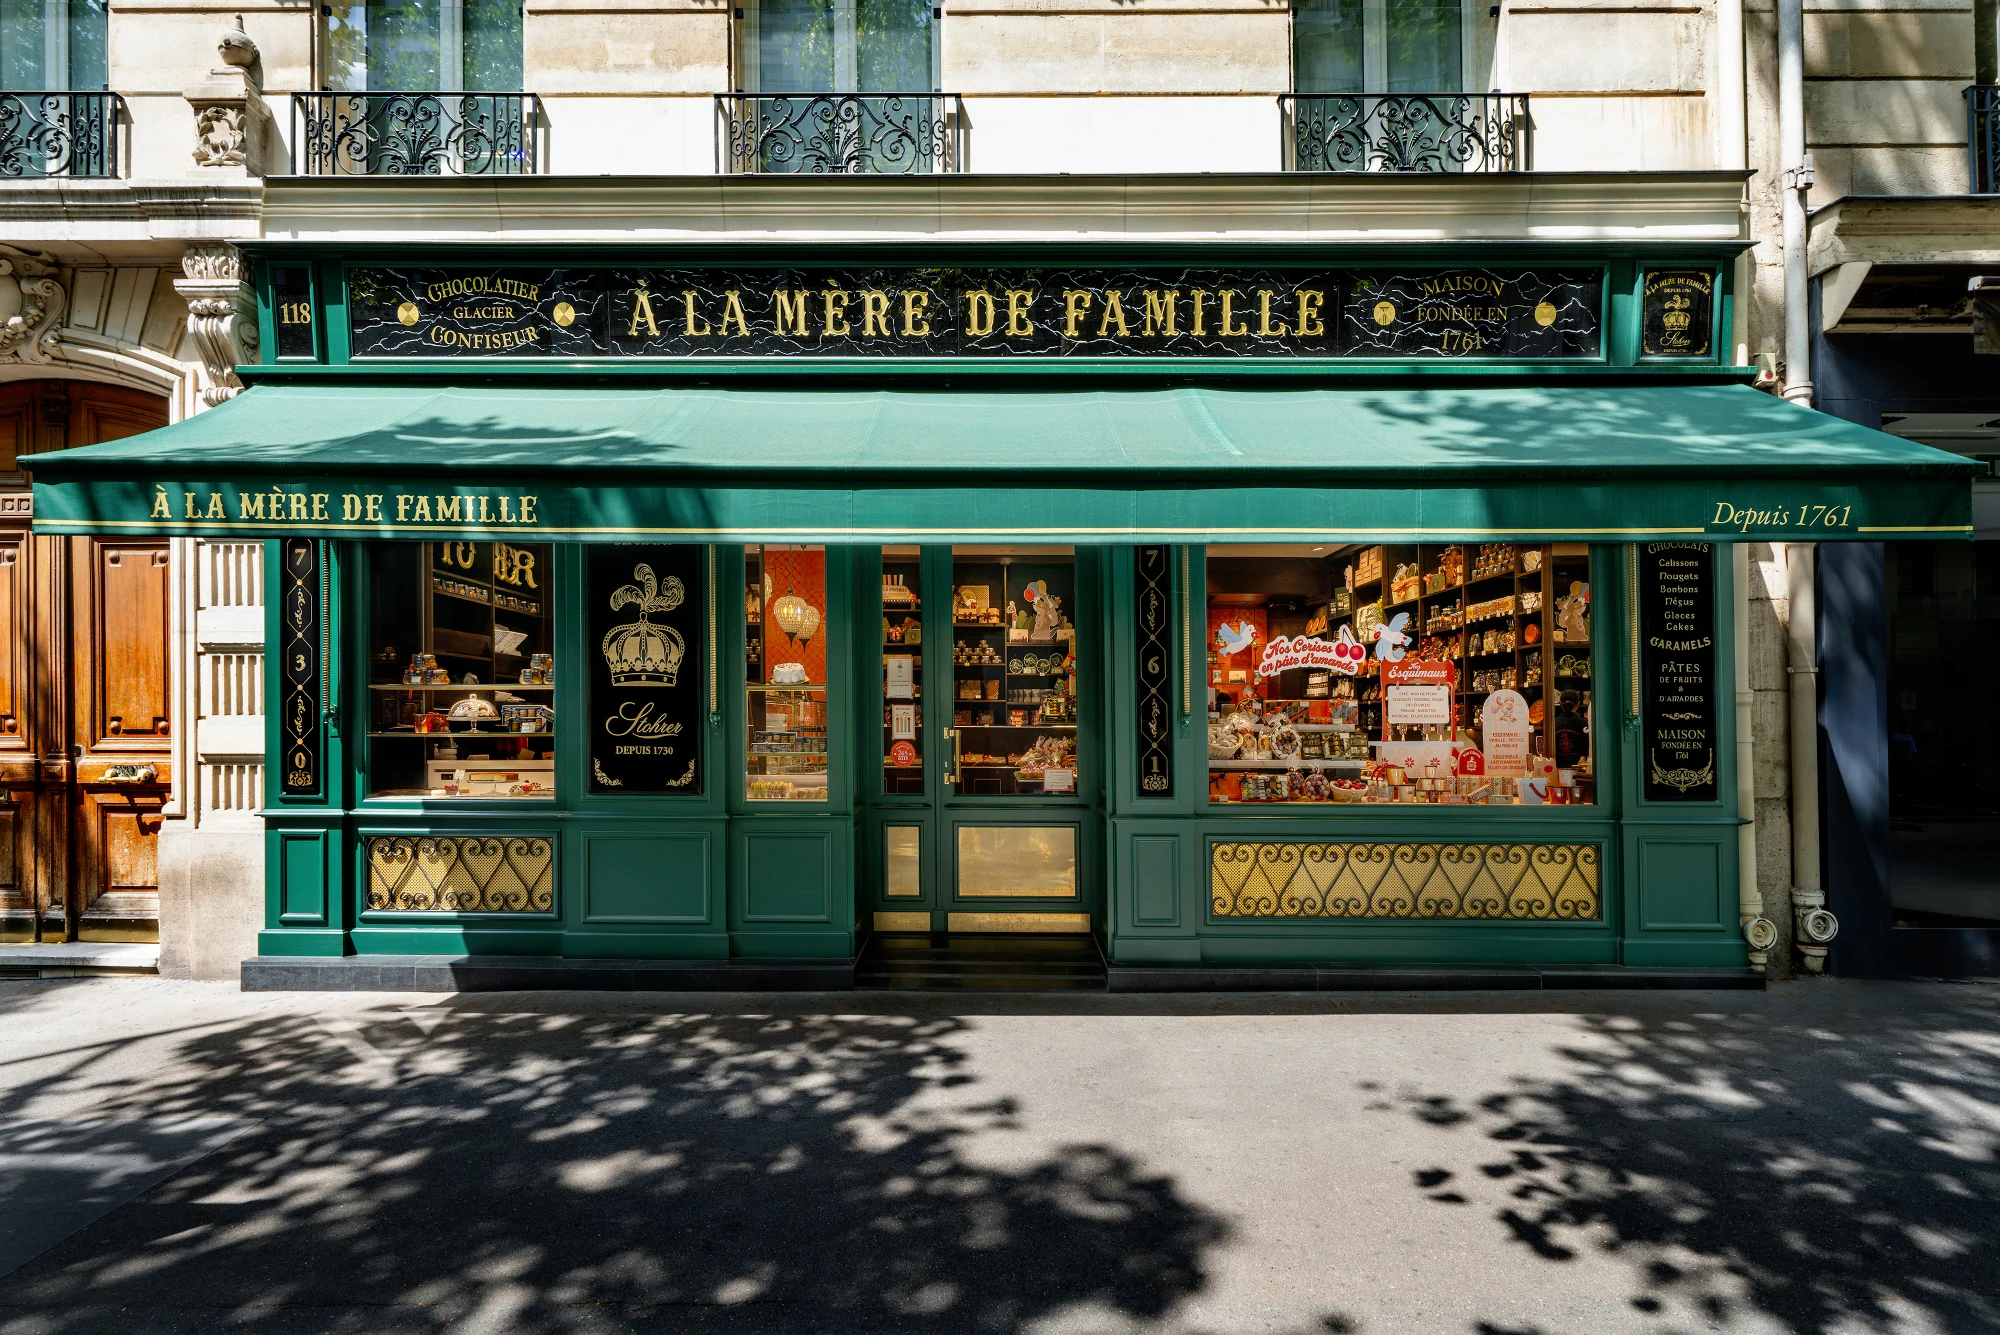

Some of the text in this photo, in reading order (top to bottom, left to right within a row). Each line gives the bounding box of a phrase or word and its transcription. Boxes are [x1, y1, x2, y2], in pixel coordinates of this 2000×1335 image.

[428, 276, 539, 302] CHOCOLATIER
[1422, 275, 1504, 297] MAISON
[1686, 278, 1711, 295] FAMILLE
[280, 302, 311, 324] 118
[453, 306, 515, 319] GLACIER
[627, 279, 1325, 336] À LA MÈRE DE FAMILLE
[1417, 304, 1508, 321] FONDÉE EN
[430, 325, 541, 349] CONFISEUR
[1441, 330, 1482, 350] 1761
[150, 483, 538, 523] À LA MÈRE DE FAMILLE
[1711, 502, 1851, 533] Depuis 1761
[294, 548, 307, 566] 7
[1146, 549, 1159, 568] 7
[1658, 558, 1699, 567] Calissons
[1659, 571, 1699, 582] Nougats
[1660, 585, 1699, 594] Bonbons
[1665, 597, 1694, 608] Négus
[1664, 611, 1695, 620] Glaces
[1666, 622, 1694, 631] Cakes
[1265, 638, 1333, 659] Nos Cerises
[295, 654, 306, 672] 3
[1147, 655, 1160, 675] 6
[1261, 662, 1274, 673] en
[1274, 655, 1300, 672] pâte
[1408, 662, 1421, 671] Nos
[1661, 660, 1700, 673] PÂTES
[1388, 665, 1447, 680] Esquimaux
[1678, 685, 1684, 693] &
[605, 701, 684, 739] Stohrer
[1657, 729, 1706, 740] MAISON
[615, 745, 674, 755] DEPUIS 1730
[1661, 741, 1691, 749] FONDÉE
[1675, 751, 1689, 759] 1761
[1150, 756, 1160, 773] 1
